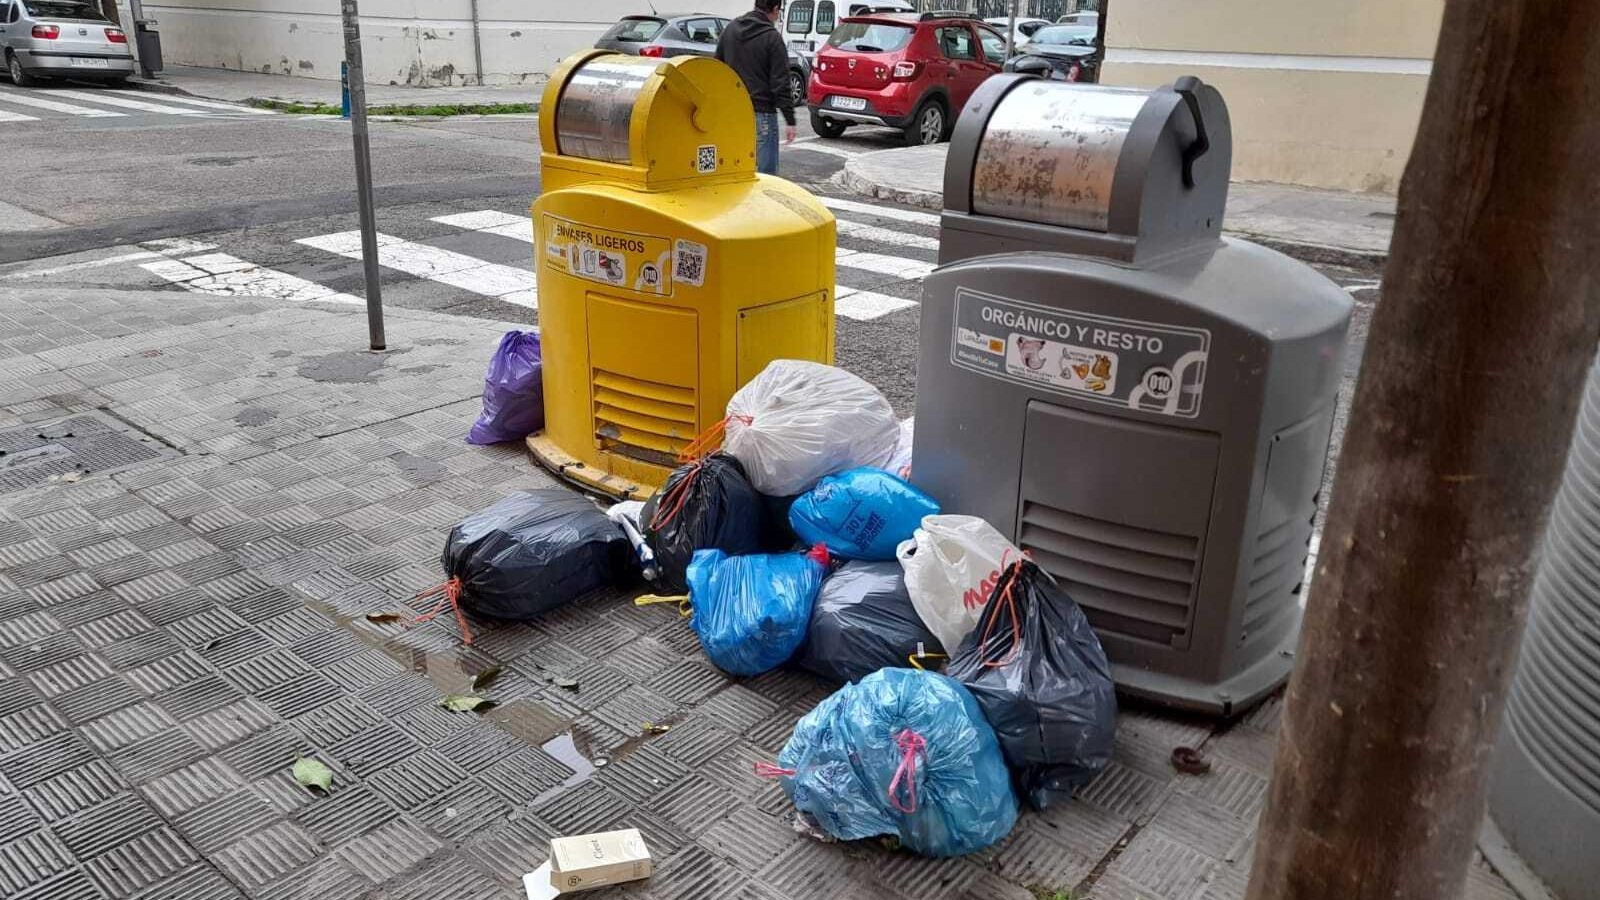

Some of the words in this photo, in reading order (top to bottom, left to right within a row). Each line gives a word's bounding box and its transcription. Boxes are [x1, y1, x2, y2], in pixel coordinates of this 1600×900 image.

[595, 234, 645, 253] LIGEROS
[981, 307, 1070, 339] ORGÁNICO
[1076, 326, 1091, 342] Y
[1093, 329, 1163, 354] RESTO
[1149, 373, 1170, 392] 010
